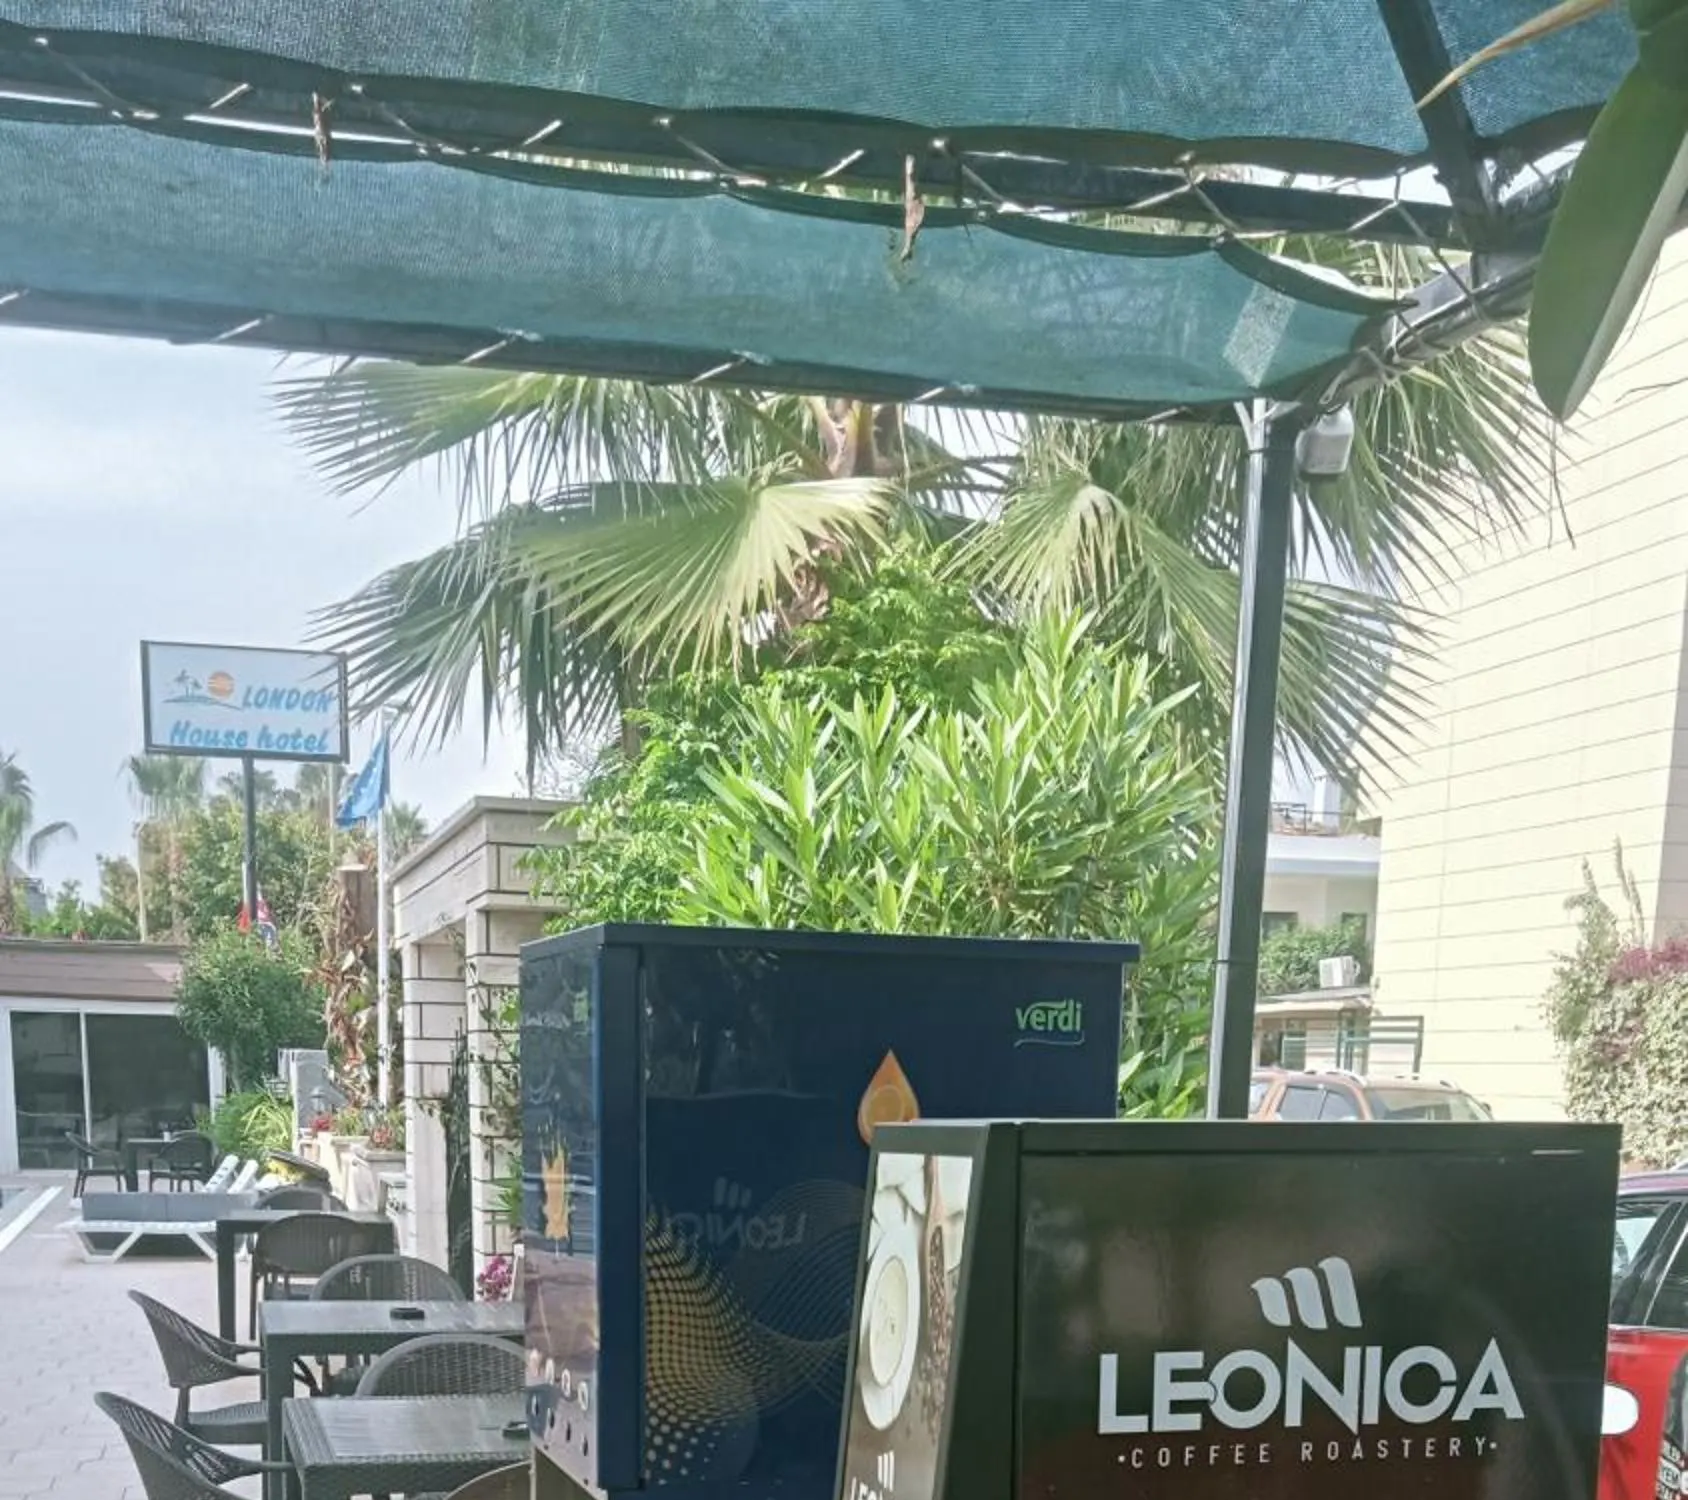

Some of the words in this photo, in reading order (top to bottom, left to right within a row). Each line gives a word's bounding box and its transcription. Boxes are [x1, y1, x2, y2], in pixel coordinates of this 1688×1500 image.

[242, 686, 334, 712] LONDON
[171, 721, 248, 748] House
[257, 725, 329, 752] hotel
[1015, 999, 1082, 1032] verdi
[1097, 1336, 1525, 1435] LEONICA
